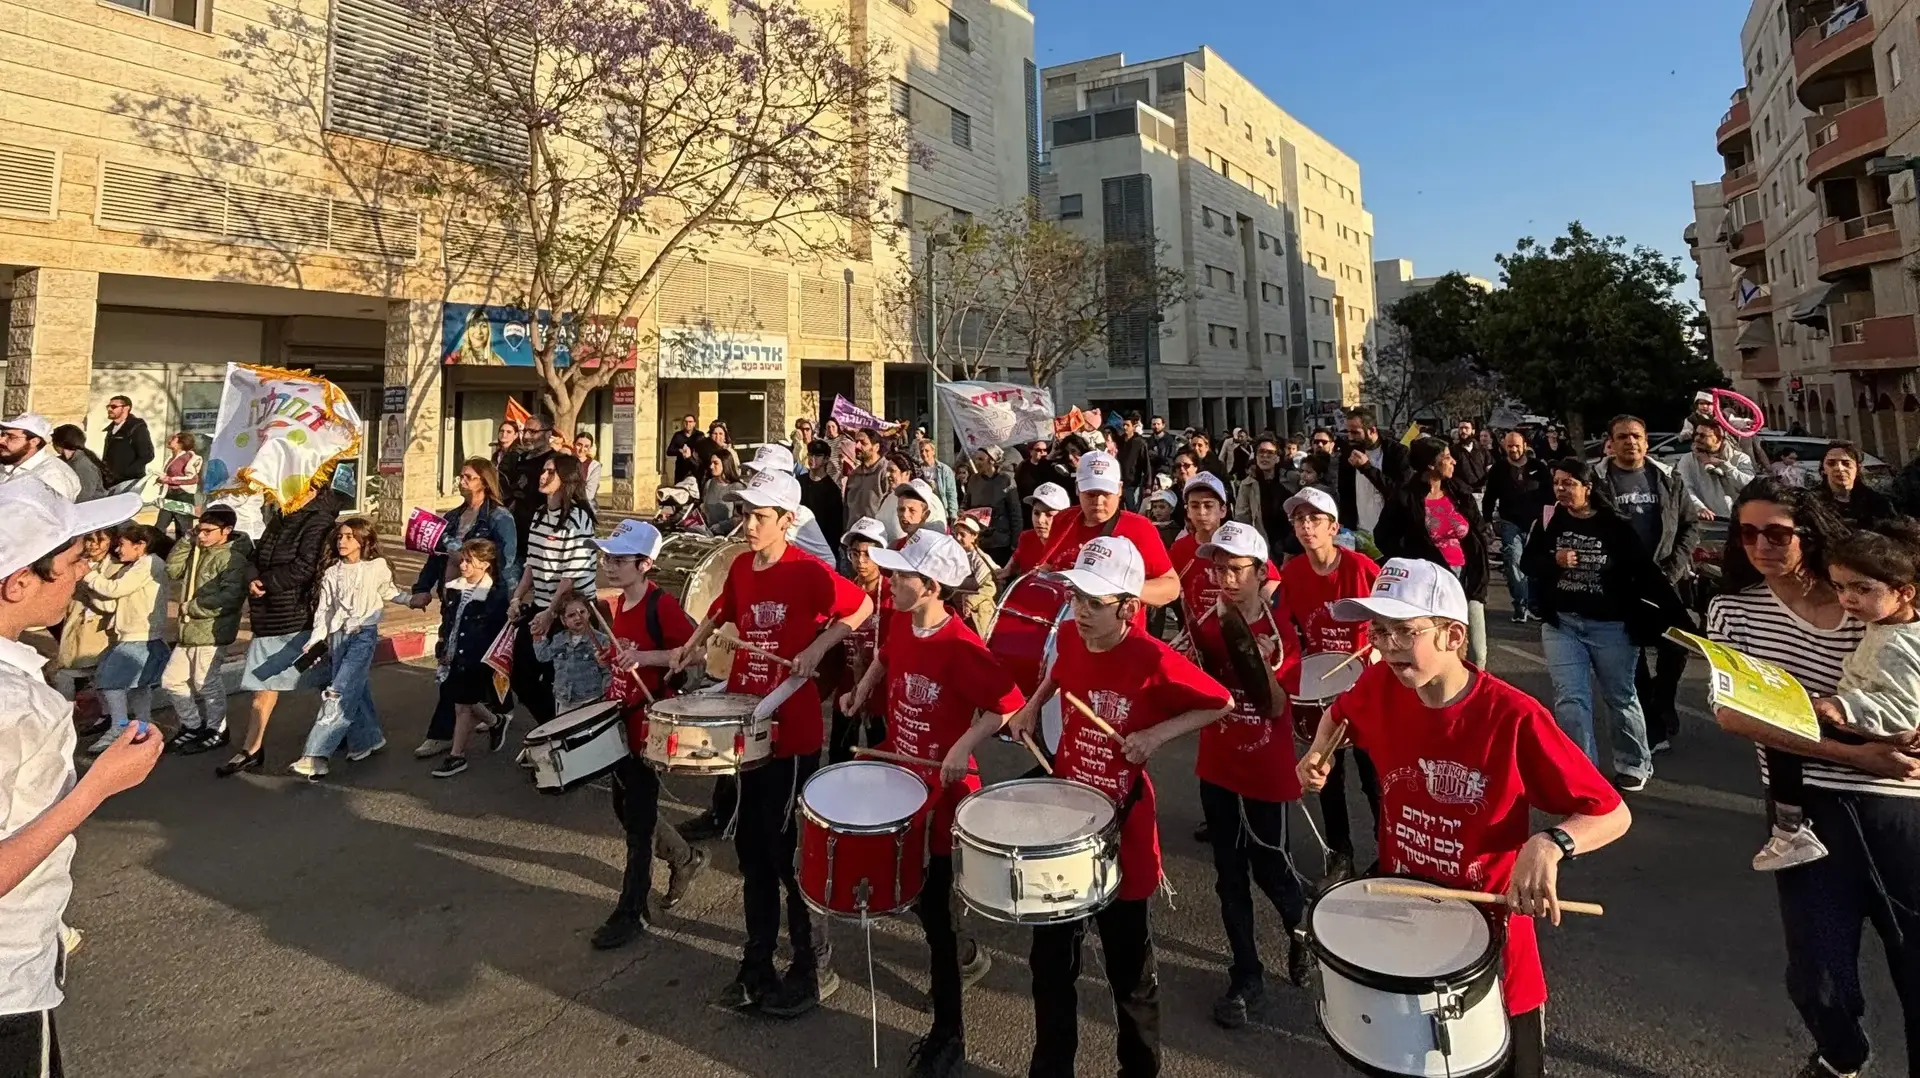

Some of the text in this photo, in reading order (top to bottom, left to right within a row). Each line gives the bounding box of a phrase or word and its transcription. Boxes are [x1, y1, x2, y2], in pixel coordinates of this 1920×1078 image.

[1402, 805, 1436, 830] ילחם
[1395, 822, 1464, 860] לכם ואתם
